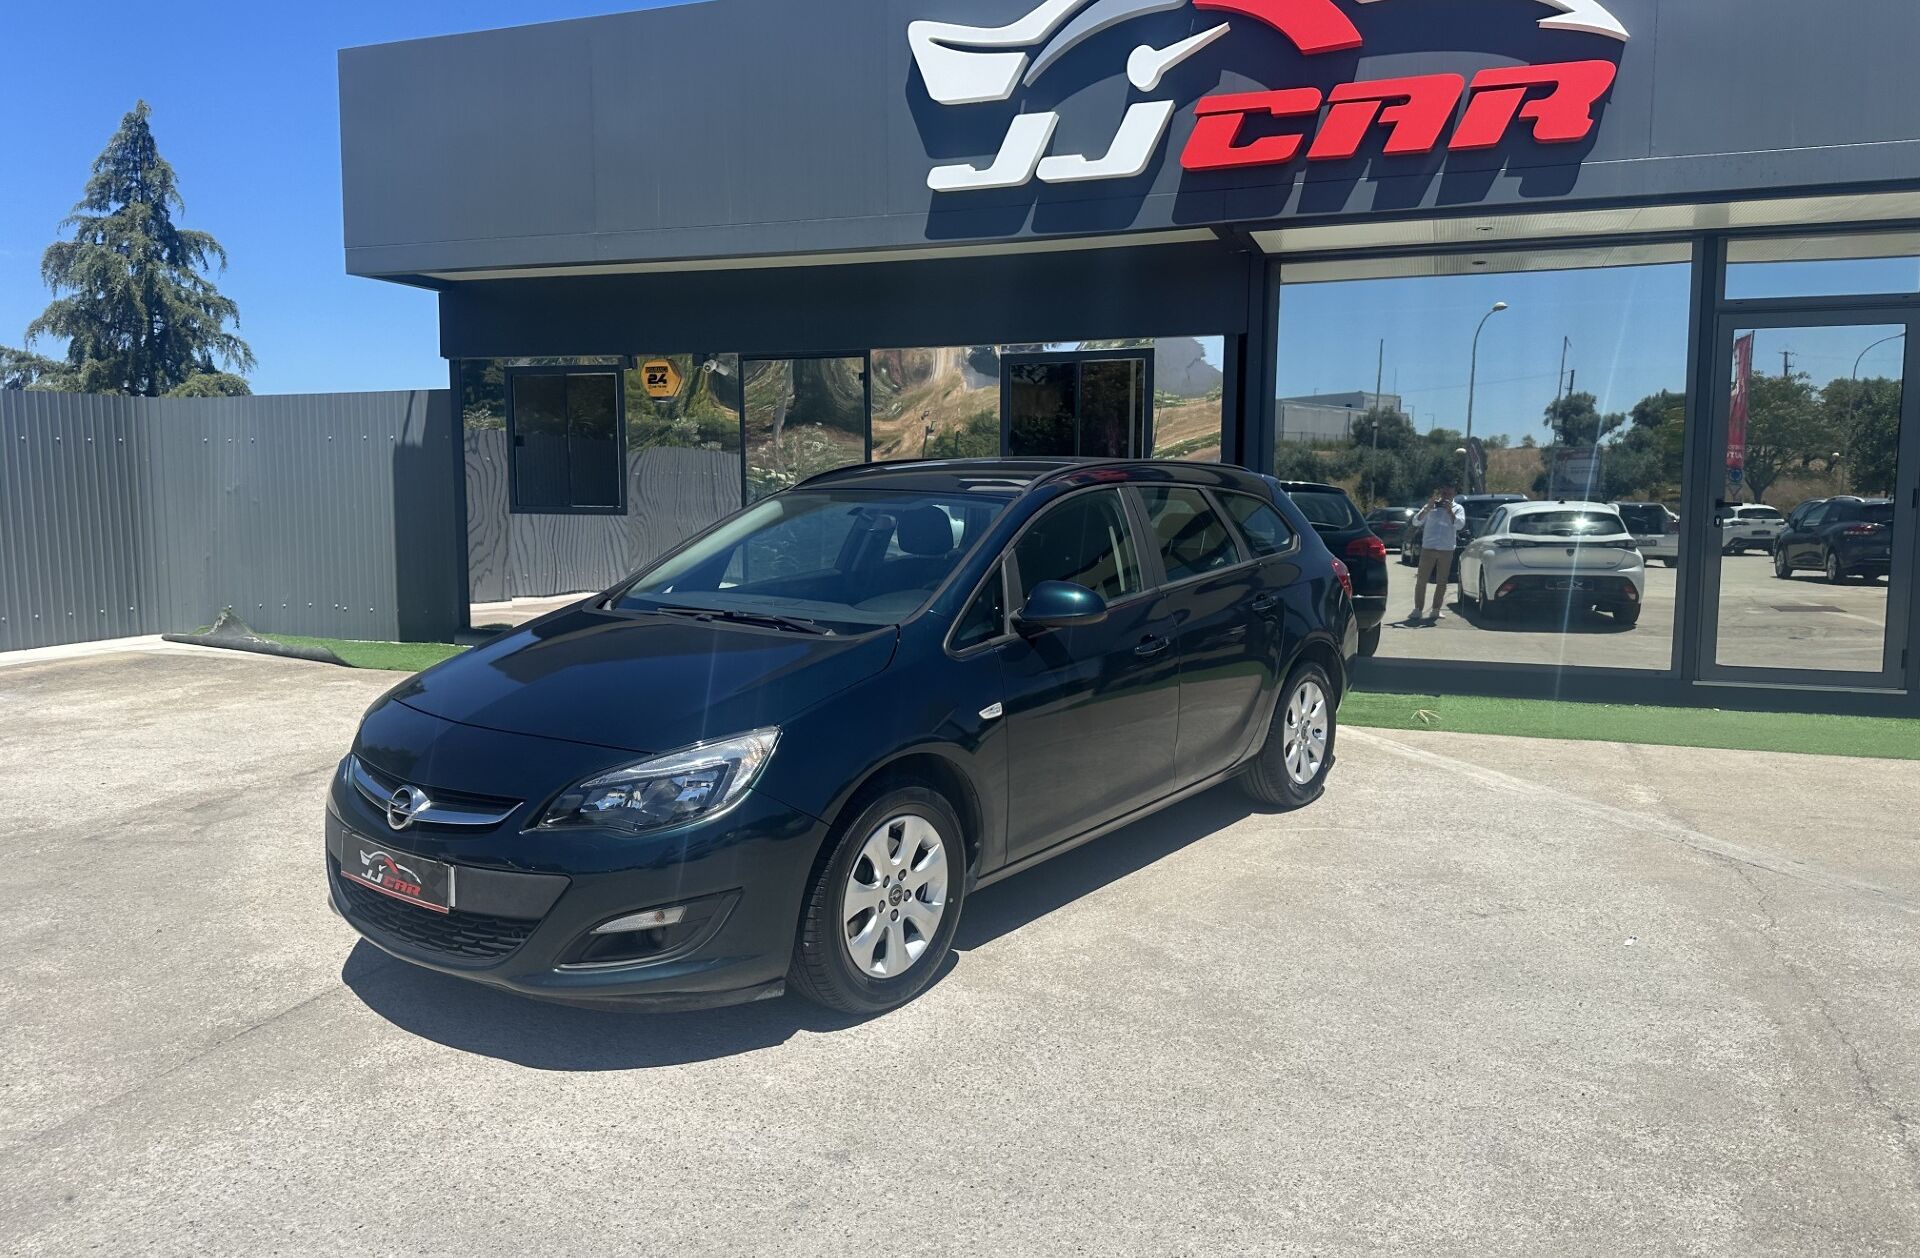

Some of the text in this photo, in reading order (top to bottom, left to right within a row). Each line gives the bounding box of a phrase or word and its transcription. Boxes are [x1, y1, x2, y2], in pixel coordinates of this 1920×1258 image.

[927, 59, 1617, 192] JJ CAR
[647, 373, 667, 385] 24
[383, 876, 421, 896] CAR
